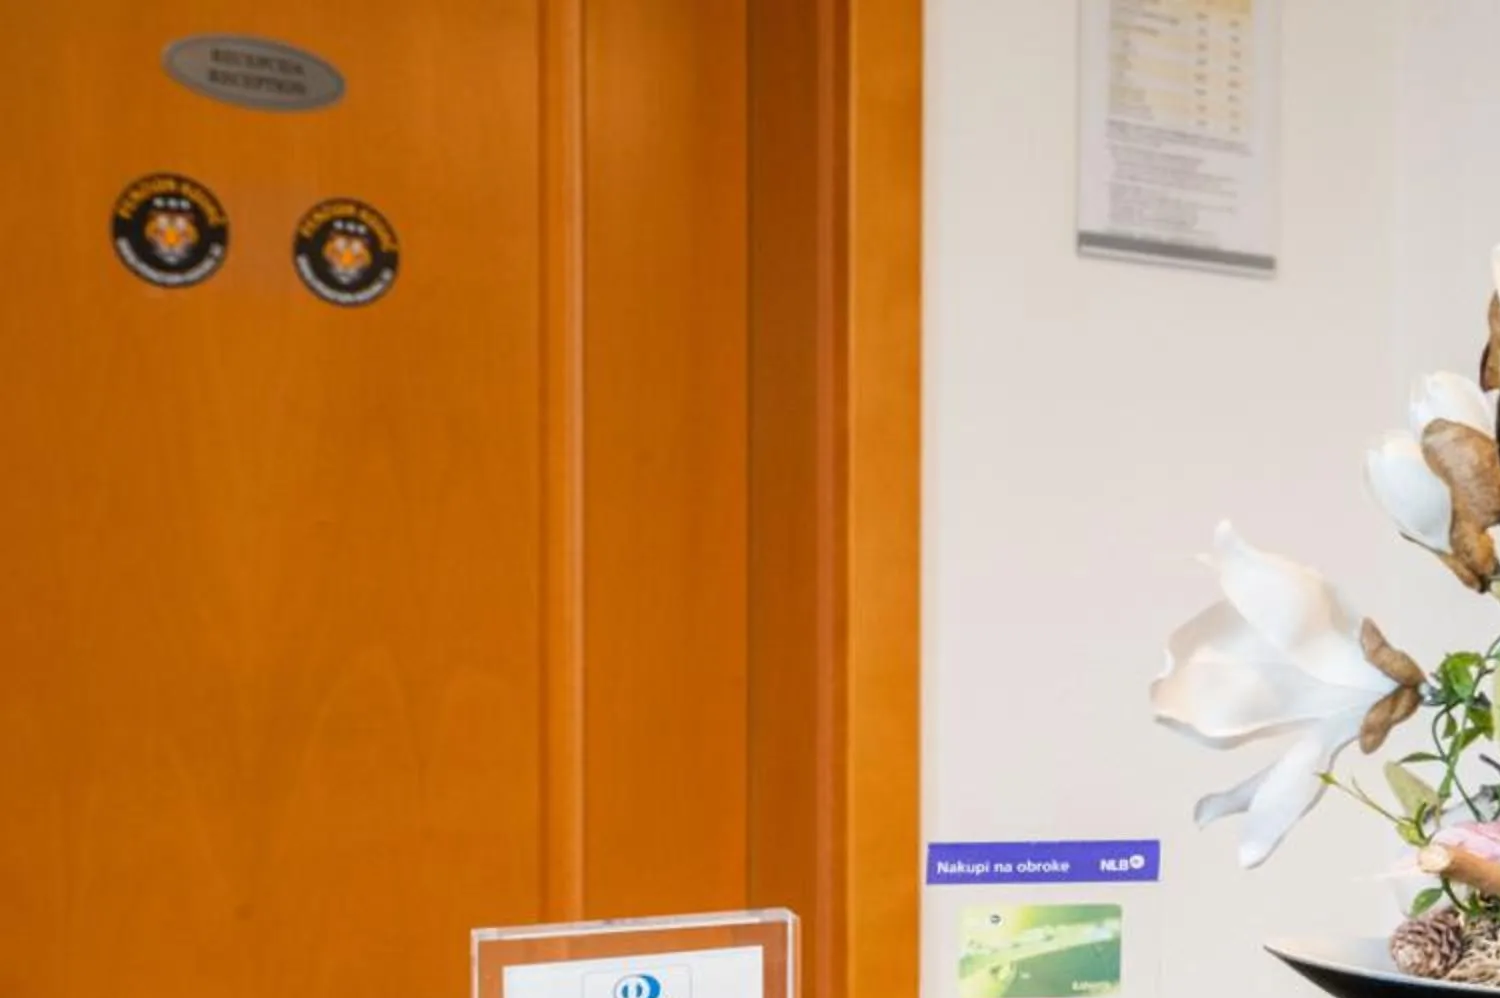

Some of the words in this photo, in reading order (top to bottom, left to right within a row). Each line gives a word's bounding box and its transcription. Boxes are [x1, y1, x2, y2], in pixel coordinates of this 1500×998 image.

[937, 860, 990, 876] Nakupi
[994, 863, 1013, 874] na
[1016, 860, 1071, 874] obroke
[1099, 858, 1130, 872] NLB
